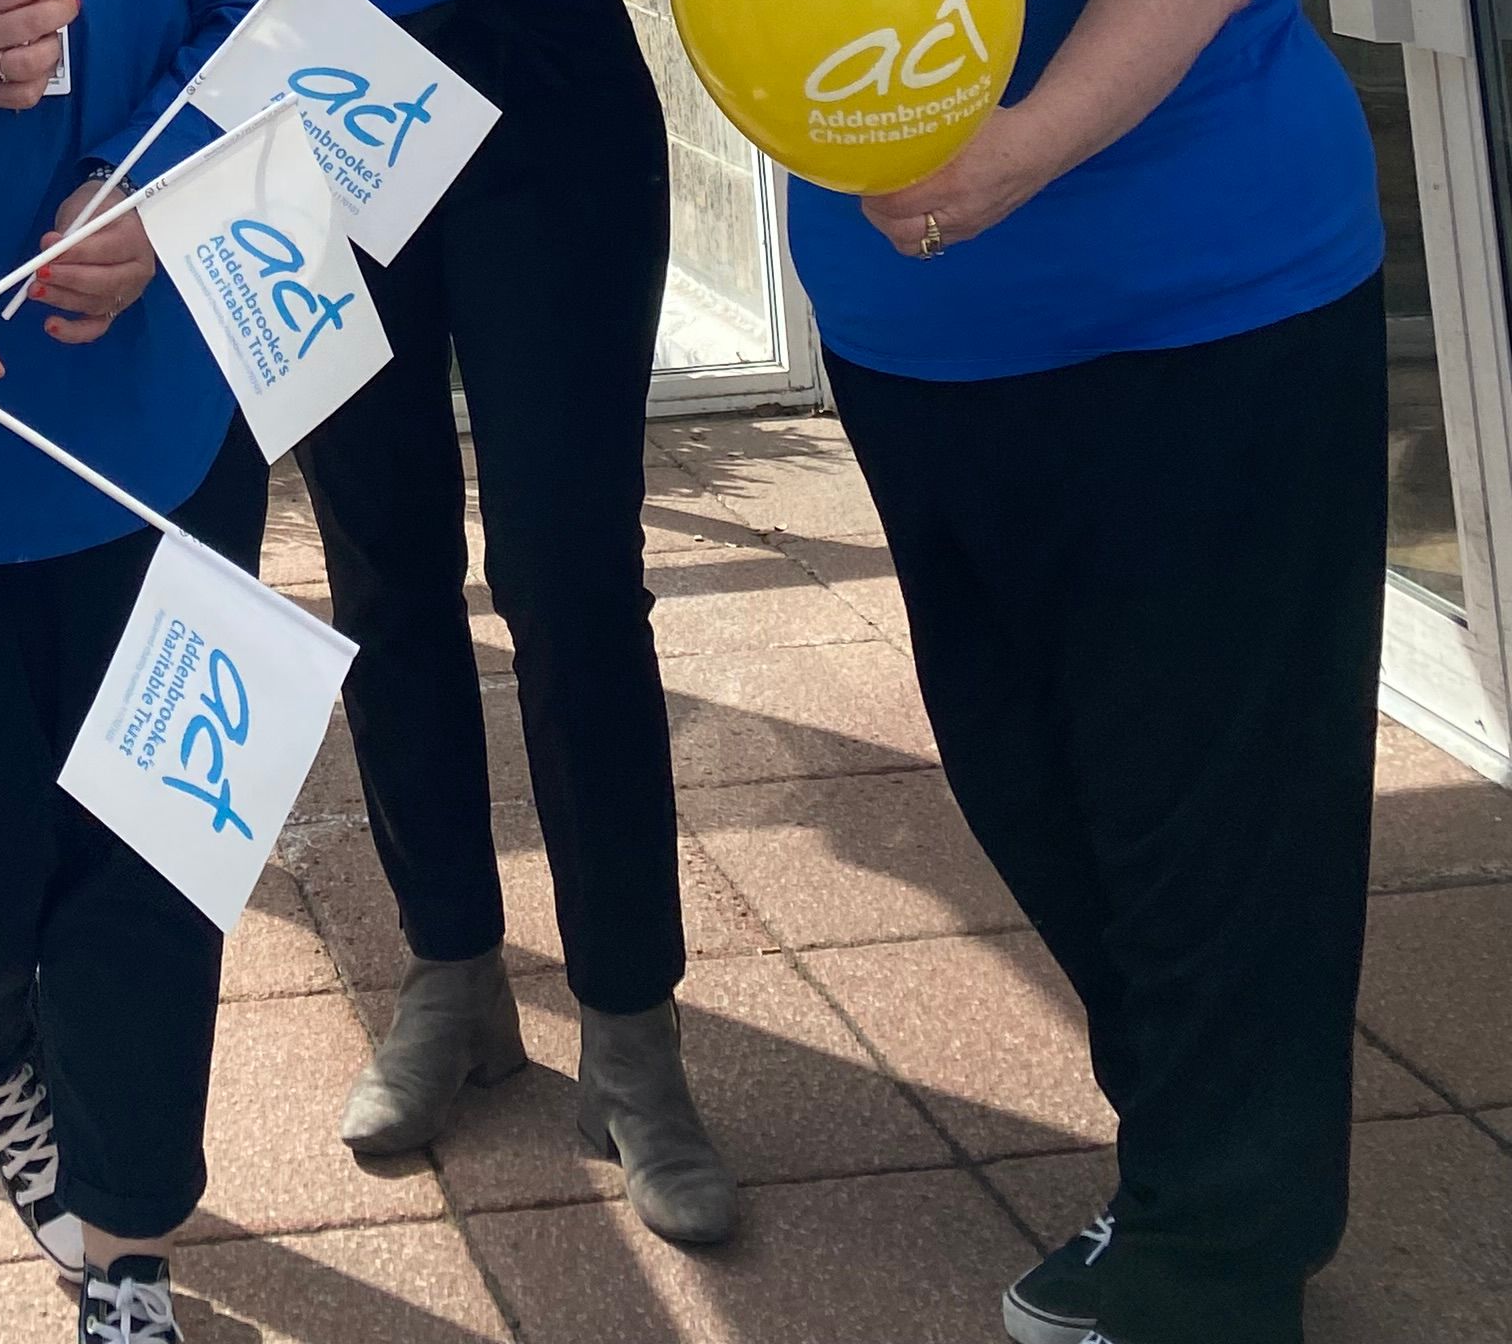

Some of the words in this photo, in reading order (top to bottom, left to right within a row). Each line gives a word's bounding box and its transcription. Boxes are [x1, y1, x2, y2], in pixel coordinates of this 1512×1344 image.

[288, 67, 438, 168] act
[808, 74, 992, 128] Addenbrooke's
[808, 121, 938, 145] Charitable
[943, 93, 991, 125] Trust
[334, 167, 372, 204] Trust
[196, 244, 252, 338] Charitable
[248, 336, 276, 387] Trust
[210, 235, 290, 377] Addenbrooke's
[231, 219, 355, 359] act
[137, 630, 205, 771] Addenbrooke's
[141, 619, 186, 706] Charitable
[119, 707, 152, 756] Trust
[162, 649, 254, 840] act
